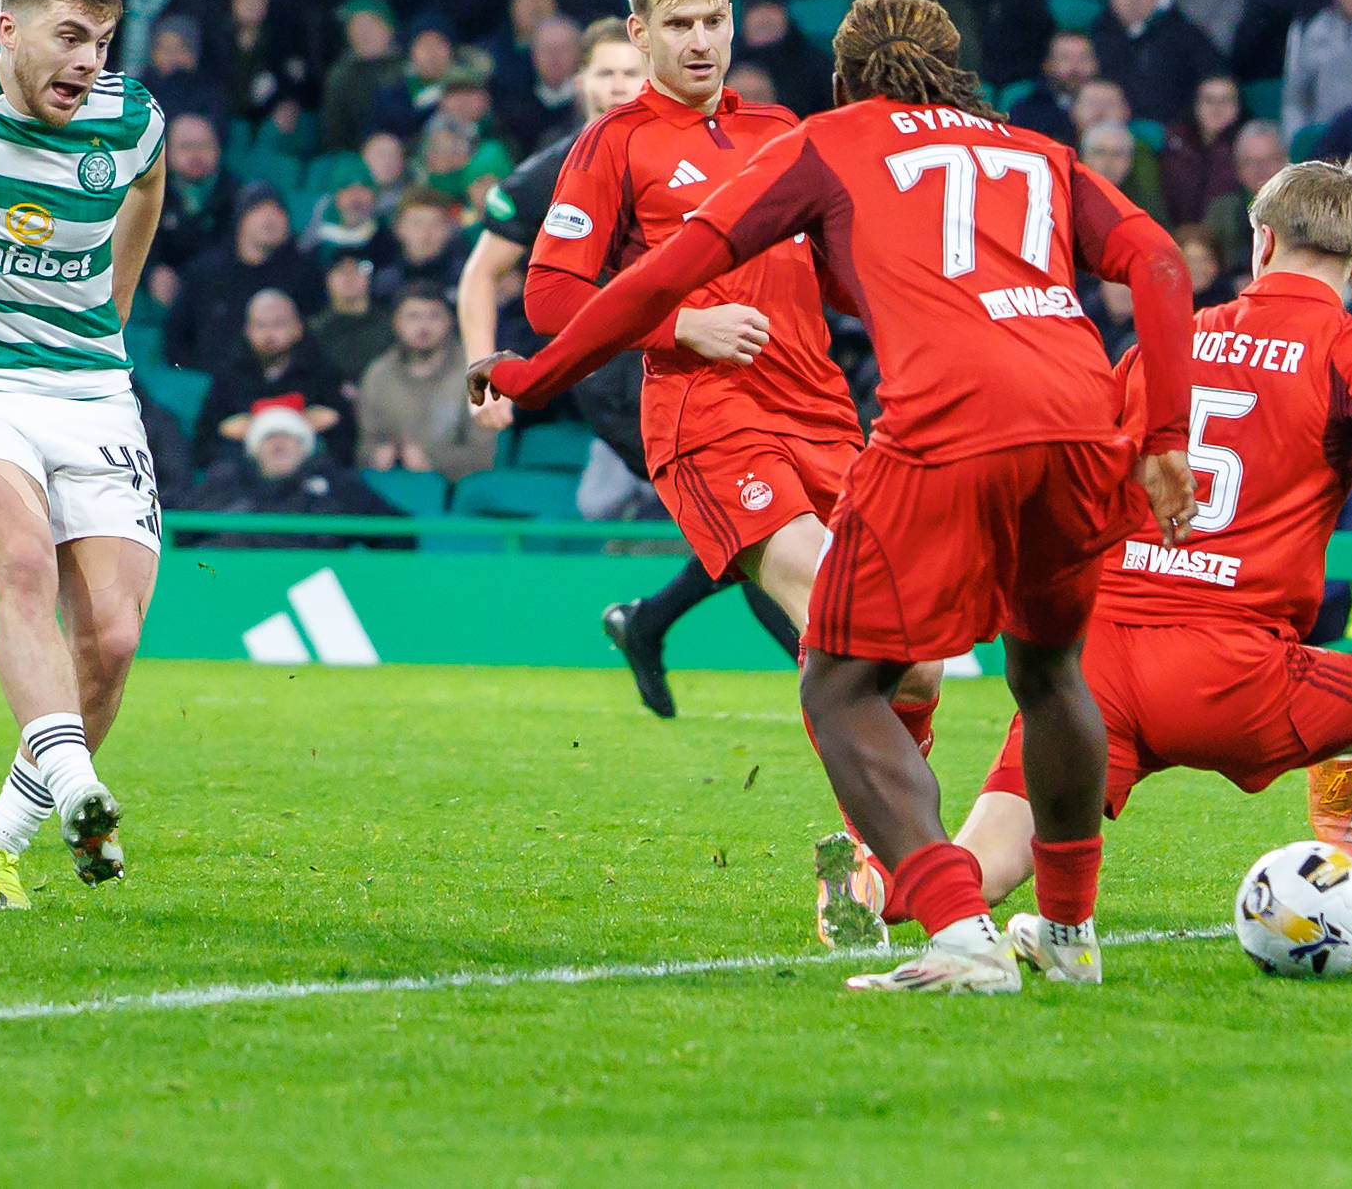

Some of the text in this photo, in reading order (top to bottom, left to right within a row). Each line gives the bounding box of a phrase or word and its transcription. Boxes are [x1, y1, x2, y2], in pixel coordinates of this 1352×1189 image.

[885, 143, 1055, 279] 77
[1187, 385, 1258, 533] 5
[1148, 544, 1242, 588] WASTE
